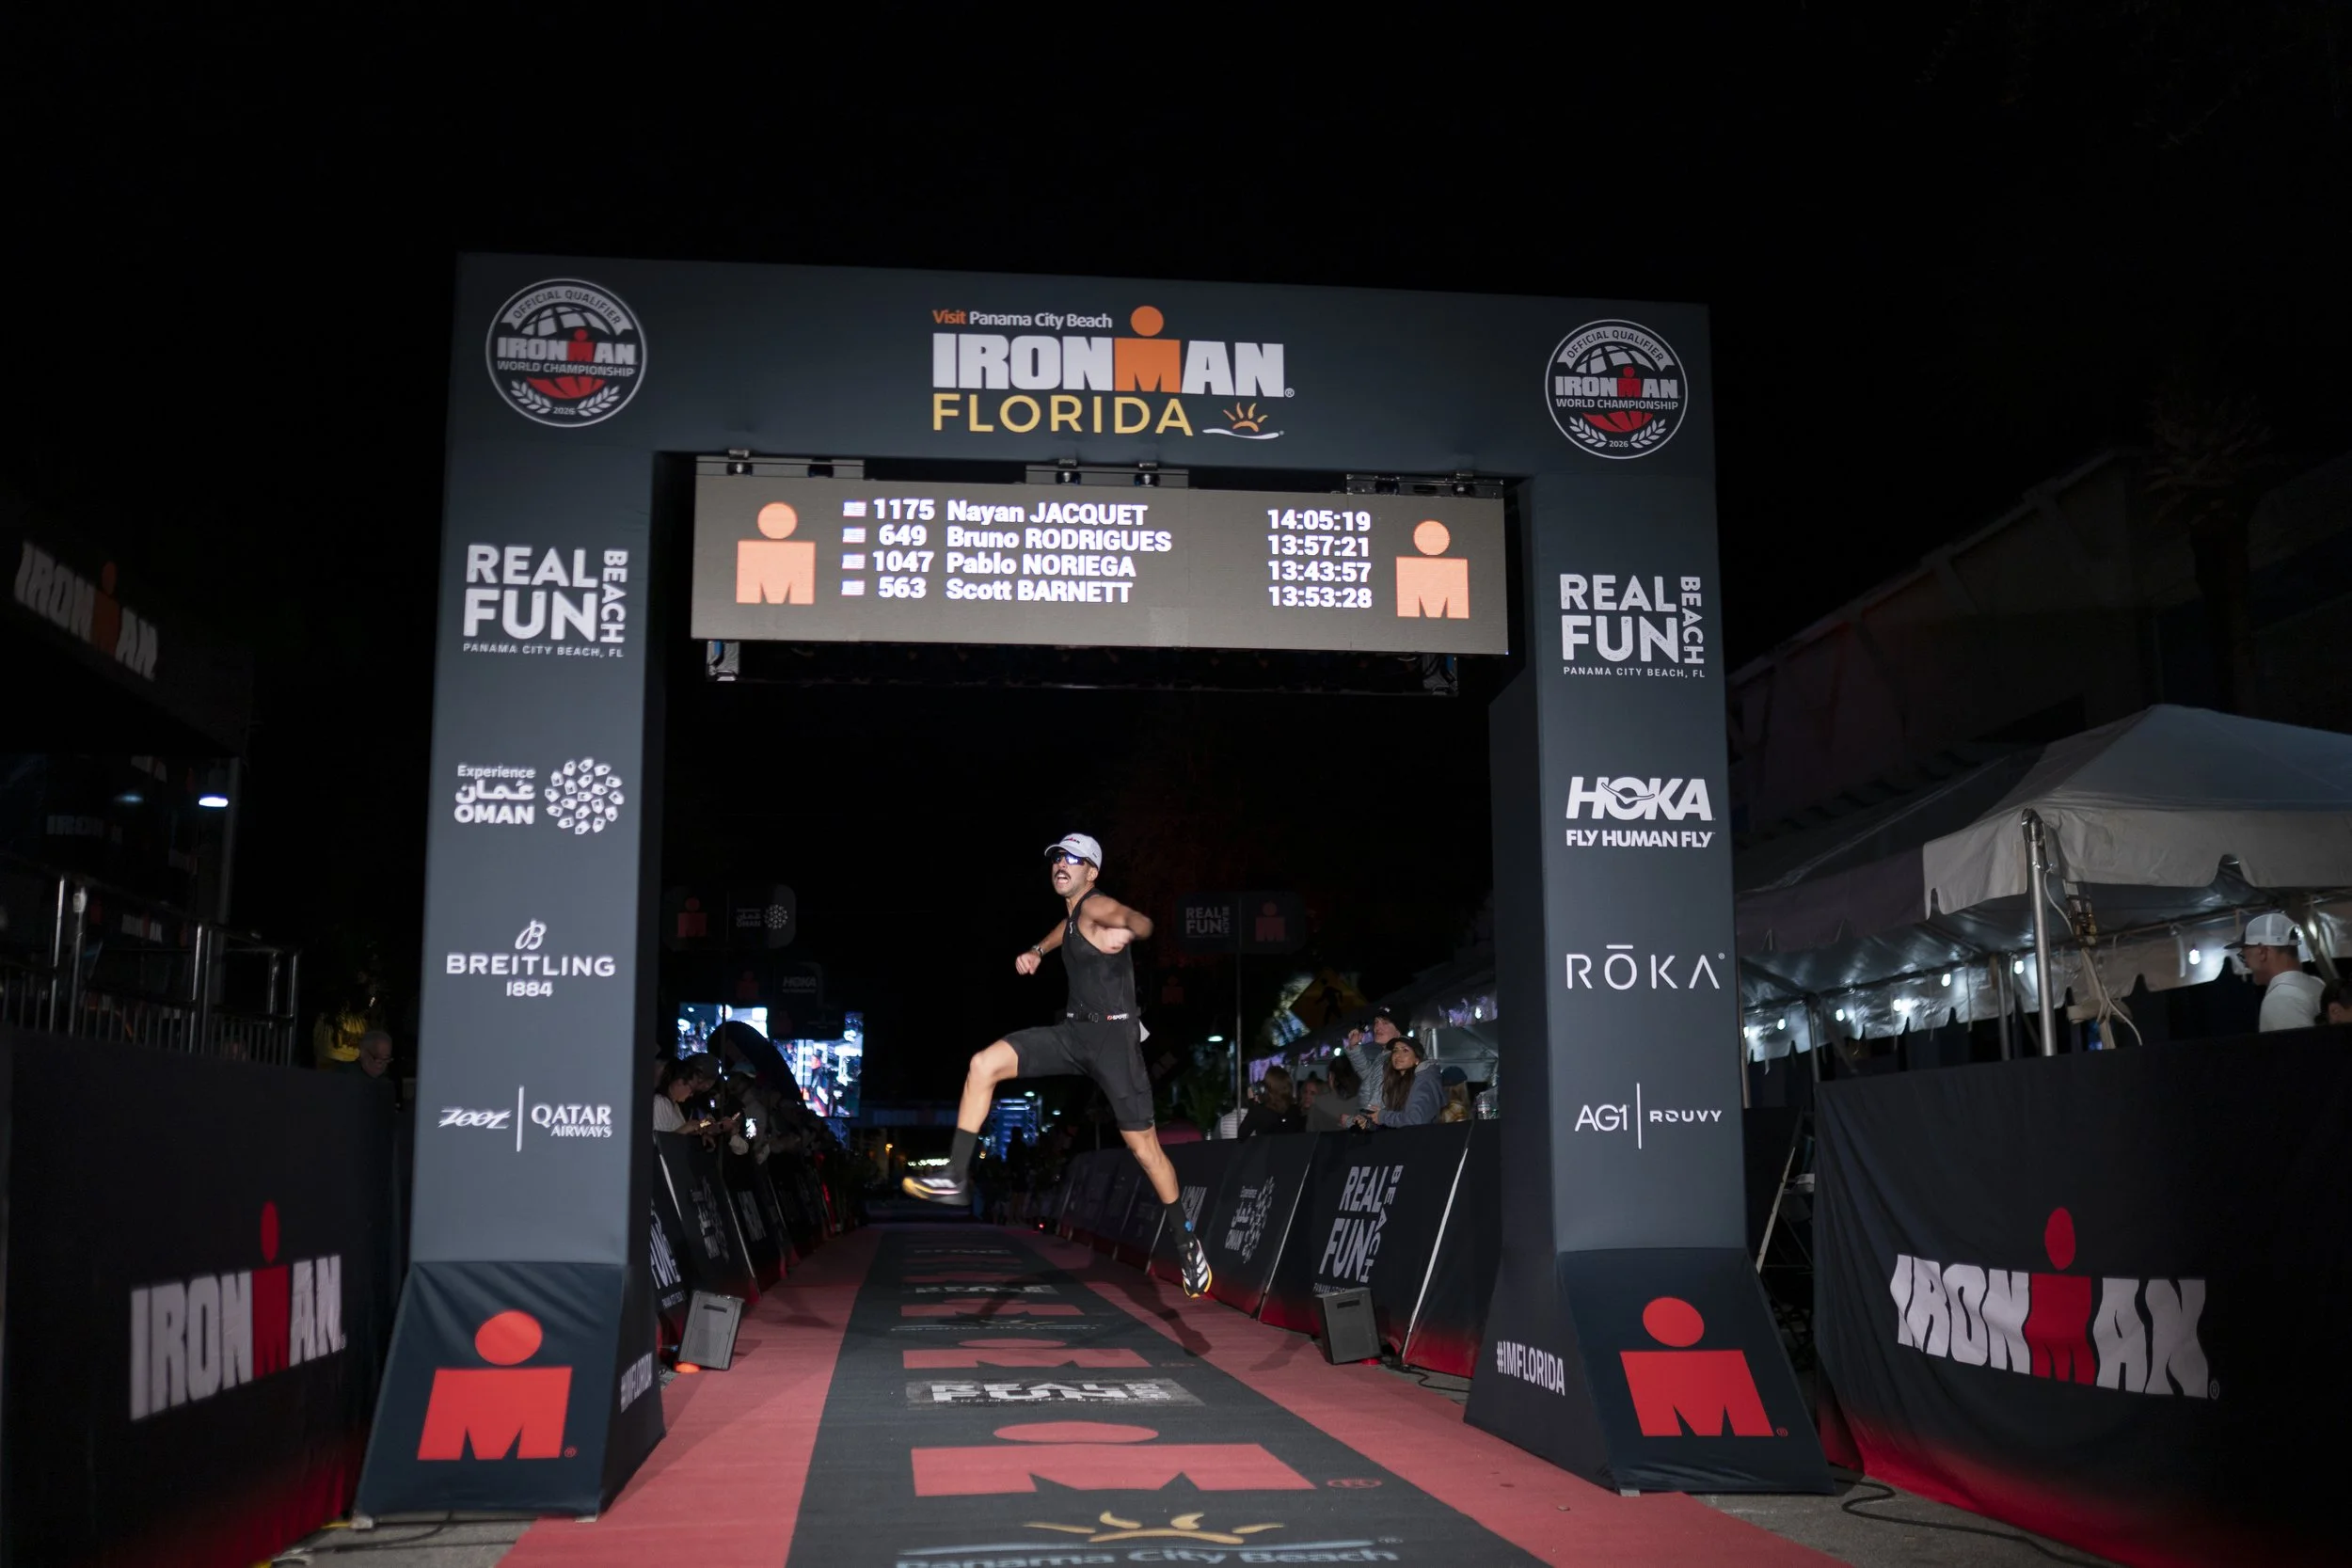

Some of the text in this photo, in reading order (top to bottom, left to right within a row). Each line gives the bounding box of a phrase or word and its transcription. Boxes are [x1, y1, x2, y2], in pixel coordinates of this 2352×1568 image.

[513, 289, 623, 325] OFFICIAL QUALIFIER
[932, 309, 1113, 330] Visit Panama City Beach
[497, 336, 638, 366] IRONMAN
[1566, 329, 1665, 362] OFFICIAL QUALIFIER
[497, 359, 636, 377] WORLD CHAMPIONSHIP
[932, 332, 1285, 399] IRONMAN
[1554, 374, 1679, 399] IRONMAN
[552, 405, 576, 416] 2026
[932, 392, 1194, 436] FLORIDA
[1556, 398, 1679, 410] WORLD CHAMPIONSHIP
[1609, 439, 1629, 449] 2026
[873, 497, 1372, 533] 1175 Nayan JACQUET 14:05:19
[879, 524, 1371, 558] 649 Bruno RODRIGUES 13:57:21
[466, 543, 599, 588] REAL
[873, 550, 1372, 584] 1047 Pablo NORIEGA 13:43:57
[599, 547, 629, 644] BEACH
[878, 577, 1373, 610] 563 Scott BARNETT 13:53:28
[1559, 573, 1677, 612] REAL
[13, 538, 161, 683] IRONMAN
[463, 588, 598, 641] FUN
[1679, 576, 1706, 665] BEACH
[463, 642, 625, 657] PANAMA CITY BEACH, FL
[1561, 614, 1680, 664] FUN
[1563, 665, 1706, 678] PANAMA CITY BEACH, FL
[456, 764, 536, 781] Experience
[1565, 776, 1713, 821] HOKA
[453, 804, 535, 825] OMAN
[1566, 830, 1713, 848] FLY HUMAN FLY
[1185, 906, 1222, 919] REAL
[1185, 919, 1223, 935] FUN
[446, 953, 616, 977] BREITLING
[506, 981, 553, 997] 1884
[783, 975, 818, 988] HOKA
[531, 1104, 612, 1127] QATAR
[550, 1124, 613, 1138] AIRWAYS
[1575, 1104, 1629, 1132] AG1
[1649, 1110, 1723, 1124] ROUVY
[1339, 1165, 1390, 1213] REAL
[1359, 1164, 1404, 1284] BEACH
[1318, 1217, 1377, 1280] FUN
[130, 1254, 342, 1423] IRONMAN
[1889, 1253, 2210, 1399] IRONMAN
[1495, 1339, 1565, 1397] #IMFLORIDA
[1127, 1549, 1227, 1564] City
[1239, 1548, 1399, 1563] Beach
